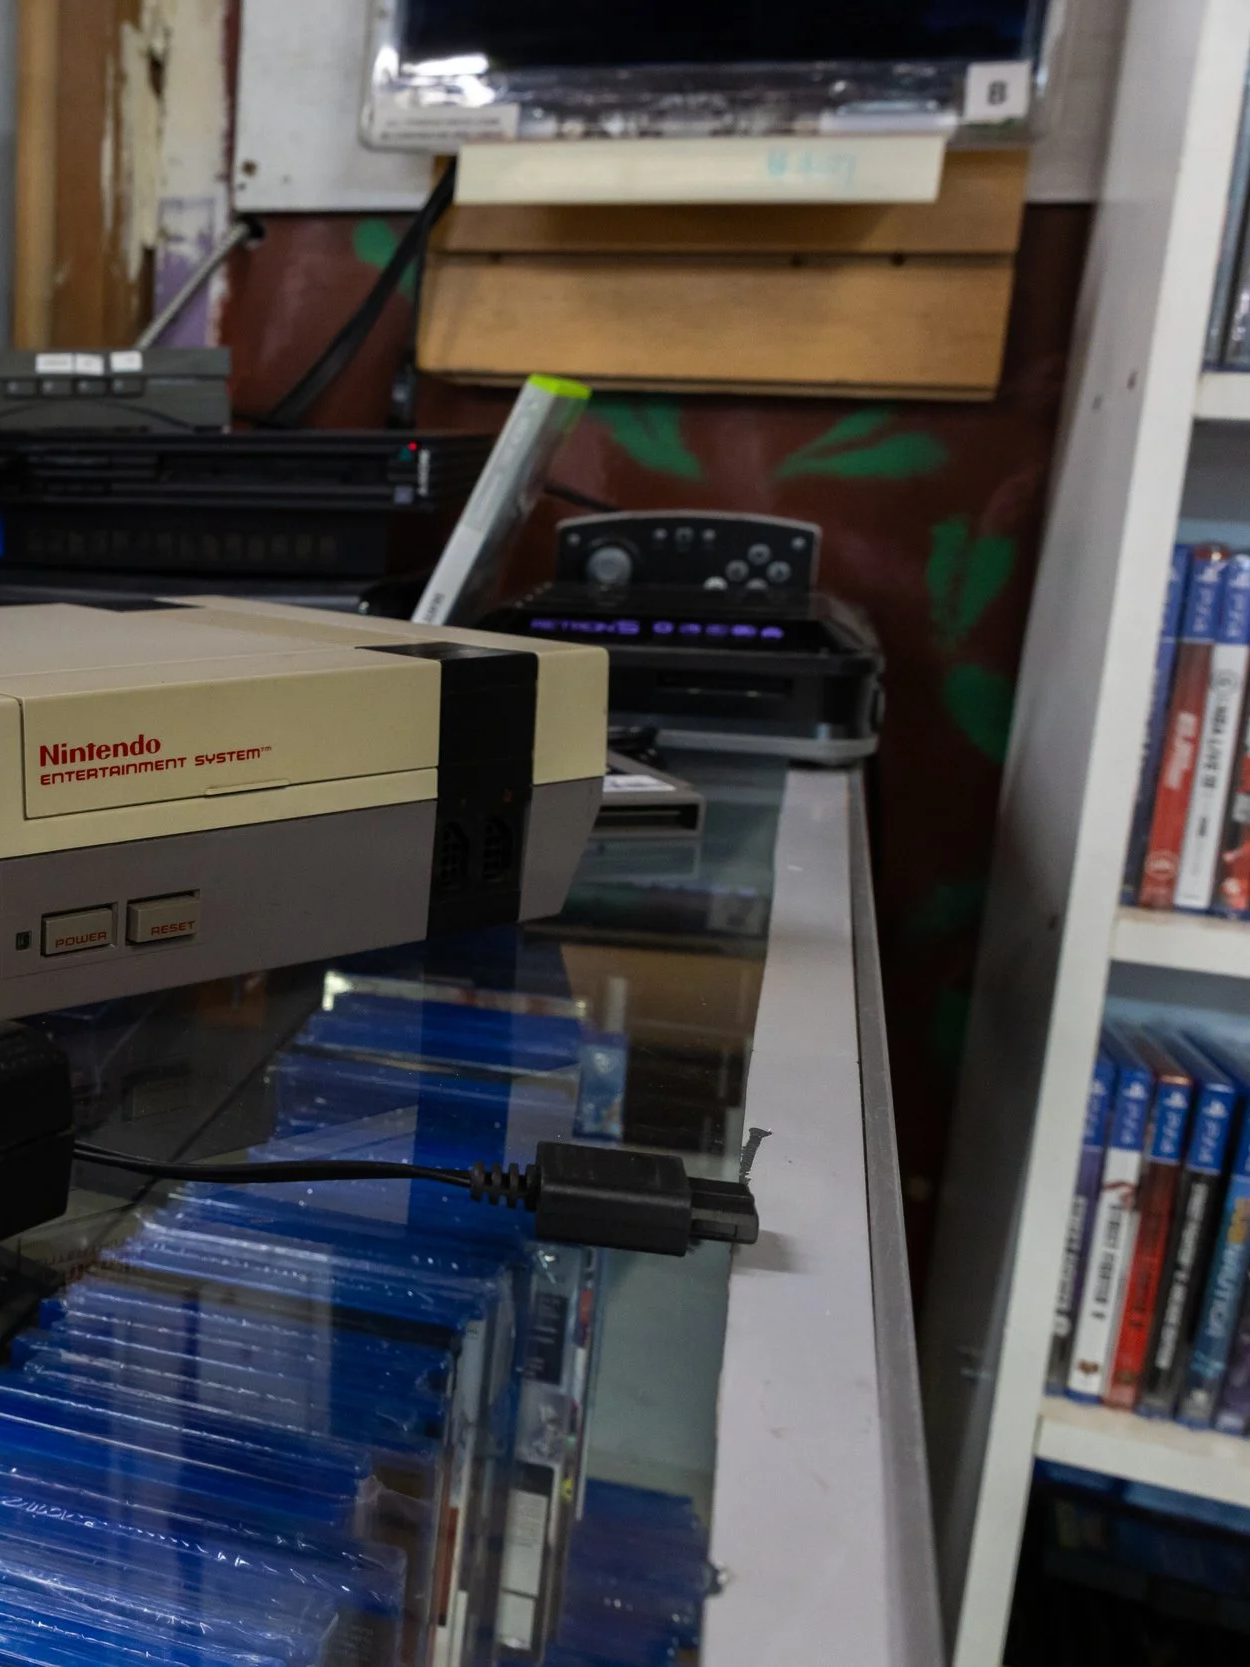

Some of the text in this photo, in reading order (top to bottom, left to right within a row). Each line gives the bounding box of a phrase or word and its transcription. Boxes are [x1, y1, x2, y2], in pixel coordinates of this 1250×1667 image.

[39, 733, 162, 768] Nintendo
[40, 757, 188, 786] ENTERTAINMENT
[55, 931, 107, 948] POWER
[150, 920, 196, 936] RESET
